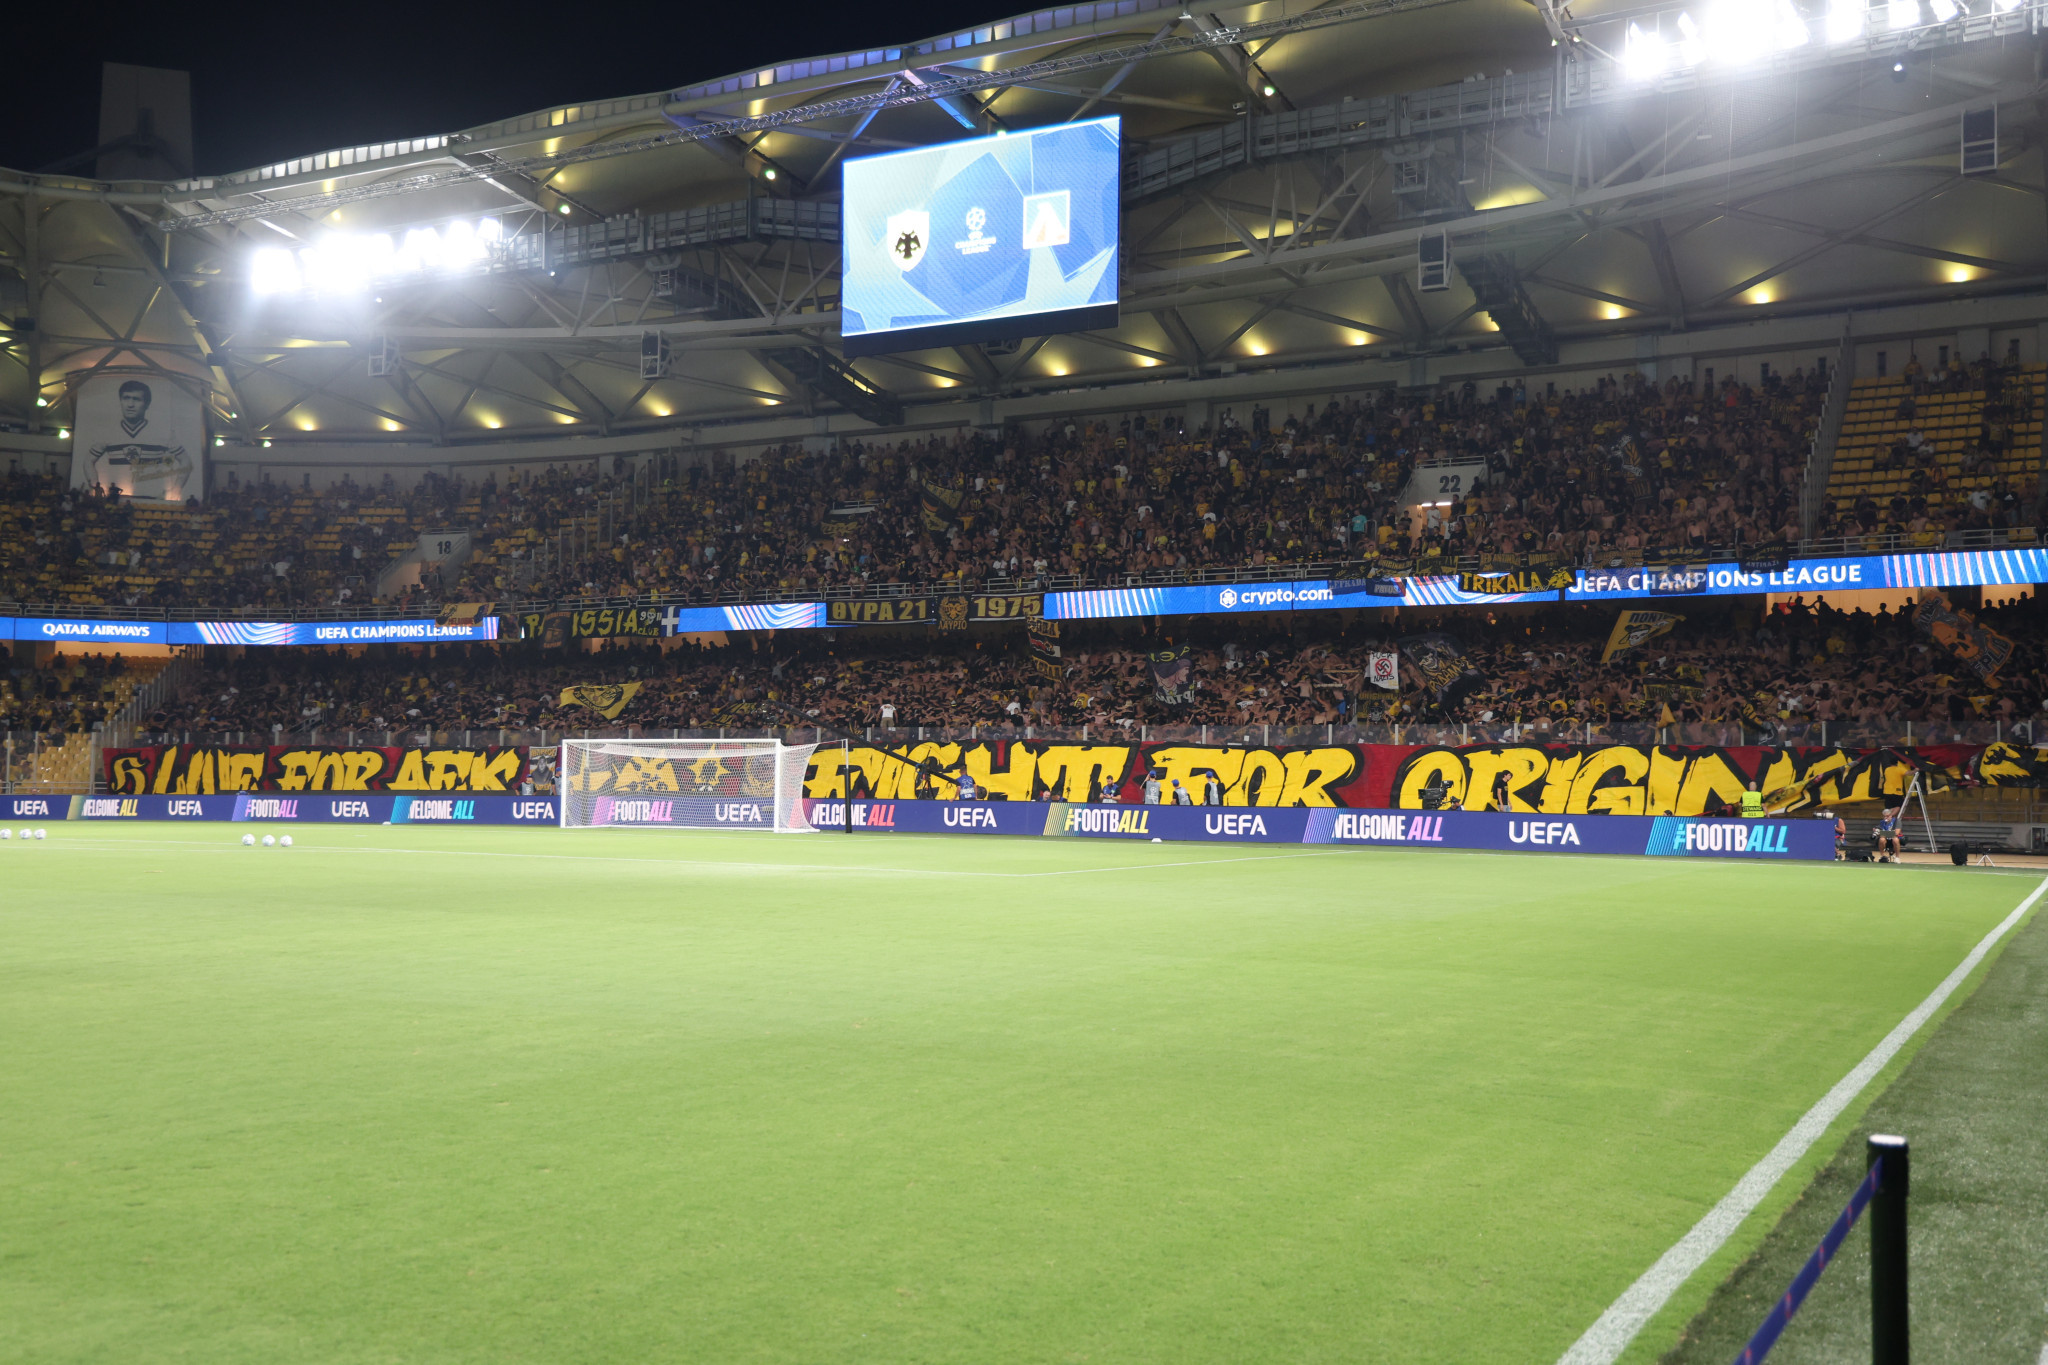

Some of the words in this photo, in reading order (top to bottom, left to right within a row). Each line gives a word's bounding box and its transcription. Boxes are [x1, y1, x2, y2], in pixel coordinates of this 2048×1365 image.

[1440, 475, 1461, 494] 22
[437, 541, 452, 555] 18
[1461, 571, 1542, 594] TRIKALA
[1769, 564, 1862, 586] LEAGUE
[1241, 588, 1333, 605] crypto.com
[899, 599, 927, 619] 21
[974, 595, 1041, 617] 1975
[42, 623, 90, 636] QATAR
[92, 624, 150, 637] AIRWAYS
[316, 626, 349, 639] UEFA
[351, 624, 425, 638] CHAMPIONS
[427, 624, 473, 637] LEAGUE
[275, 749, 384, 791] FOR
[386, 748, 521, 791] AEK
[1149, 746, 1356, 809] FOR
[13, 800, 49, 816] UEFA
[119, 798, 138, 817] ALL
[168, 800, 203, 816] UEFA
[331, 801, 370, 818] UEFA
[453, 800, 475, 820] ALL
[512, 801, 555, 819] UEFA
[715, 803, 762, 822] UEFA
[867, 803, 895, 827] ALL
[943, 807, 998, 828] UEFA
[1205, 813, 1268, 836] UEFA
[1407, 815, 1444, 842] ALL
[1508, 820, 1582, 846] UEFA
